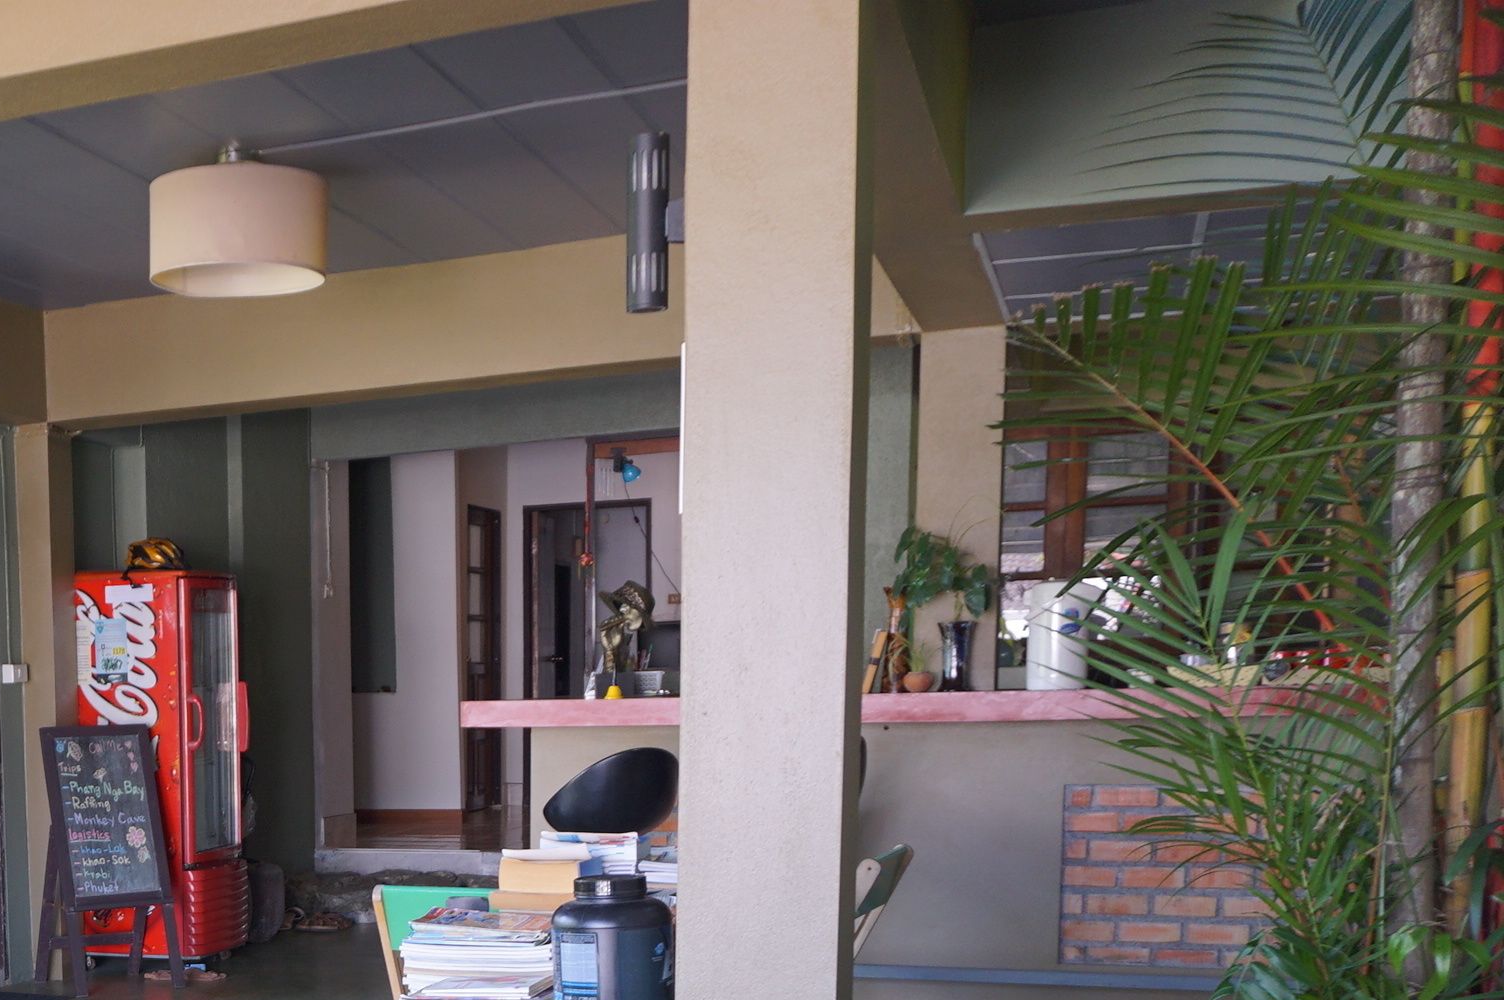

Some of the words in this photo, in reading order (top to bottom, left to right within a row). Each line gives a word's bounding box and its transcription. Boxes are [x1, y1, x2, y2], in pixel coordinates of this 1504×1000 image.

[57, 762, 82, 773] Trips
[103, 782, 124, 802] Nga
[124, 780, 145, 801] Bay
[117, 812, 147, 824] Cave
